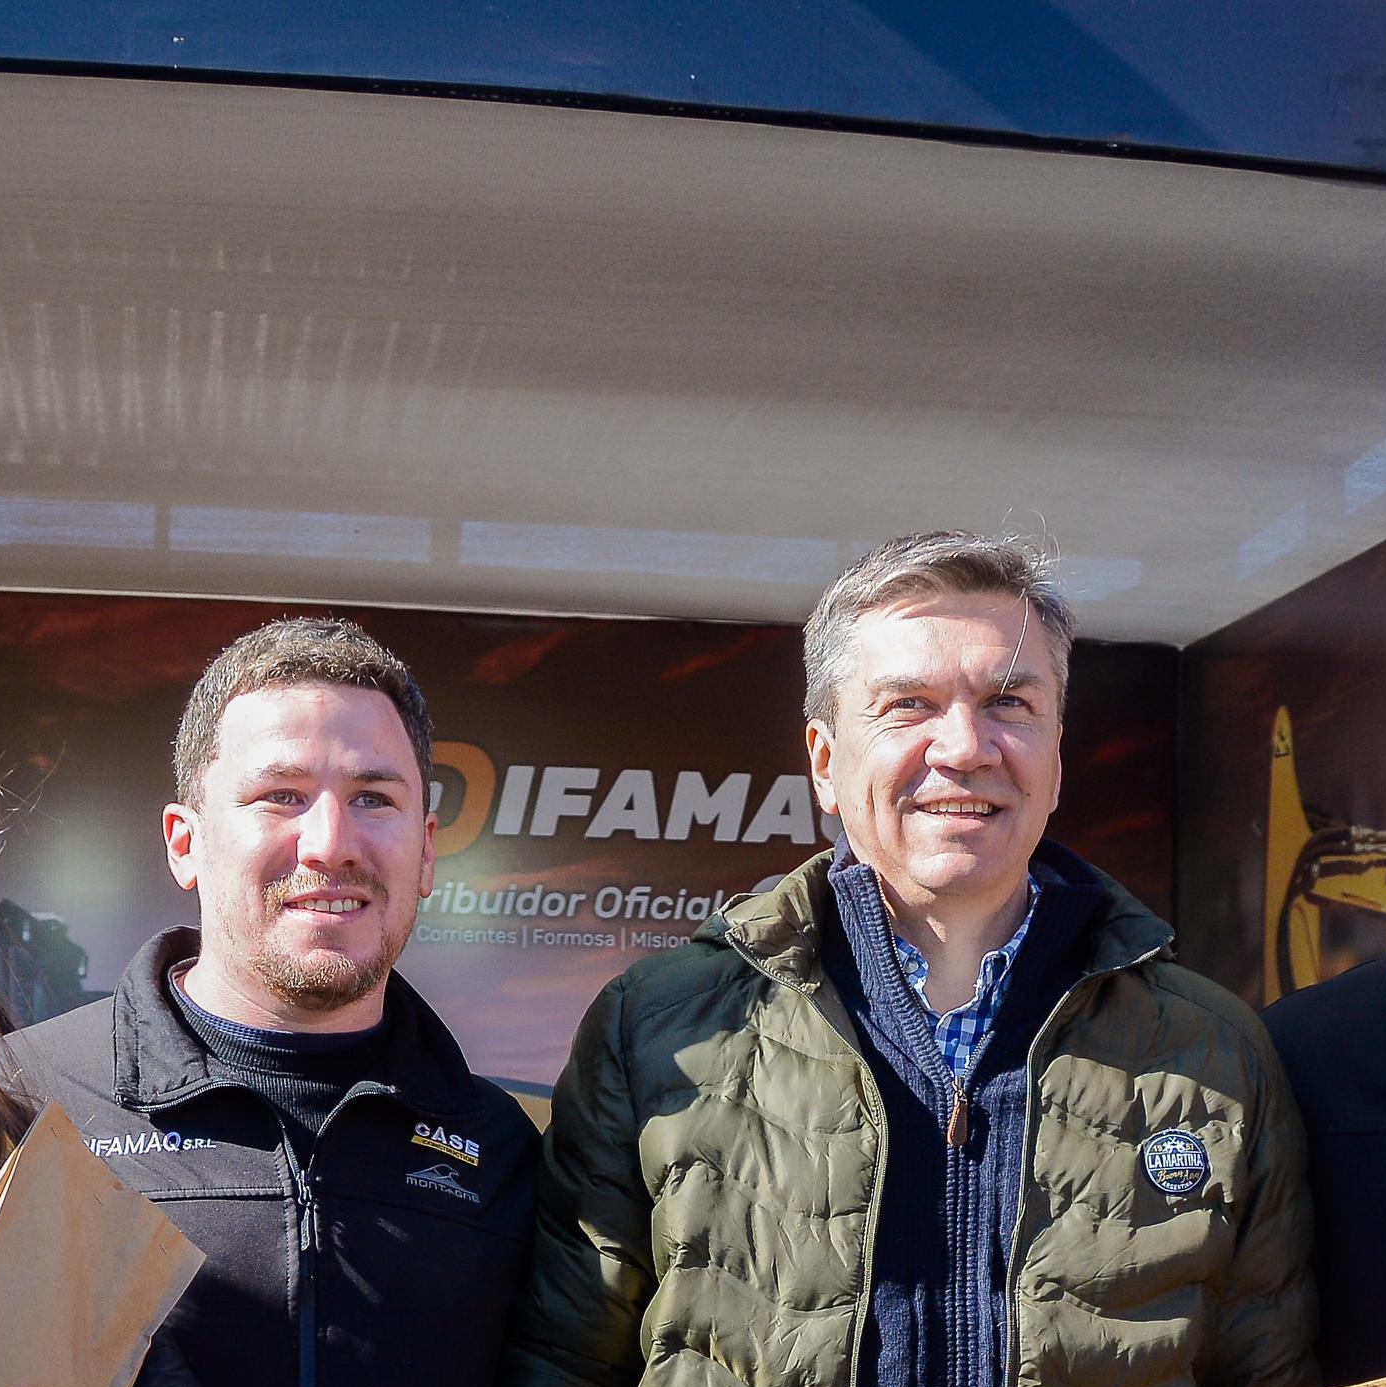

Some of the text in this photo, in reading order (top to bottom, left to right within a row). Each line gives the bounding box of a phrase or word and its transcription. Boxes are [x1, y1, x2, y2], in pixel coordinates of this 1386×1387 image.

[594, 886, 724, 921] Oficial
[415, 925, 518, 944] Corrientes
[532, 928, 616, 946] Formosa
[414, 1121, 480, 1158] CASE
